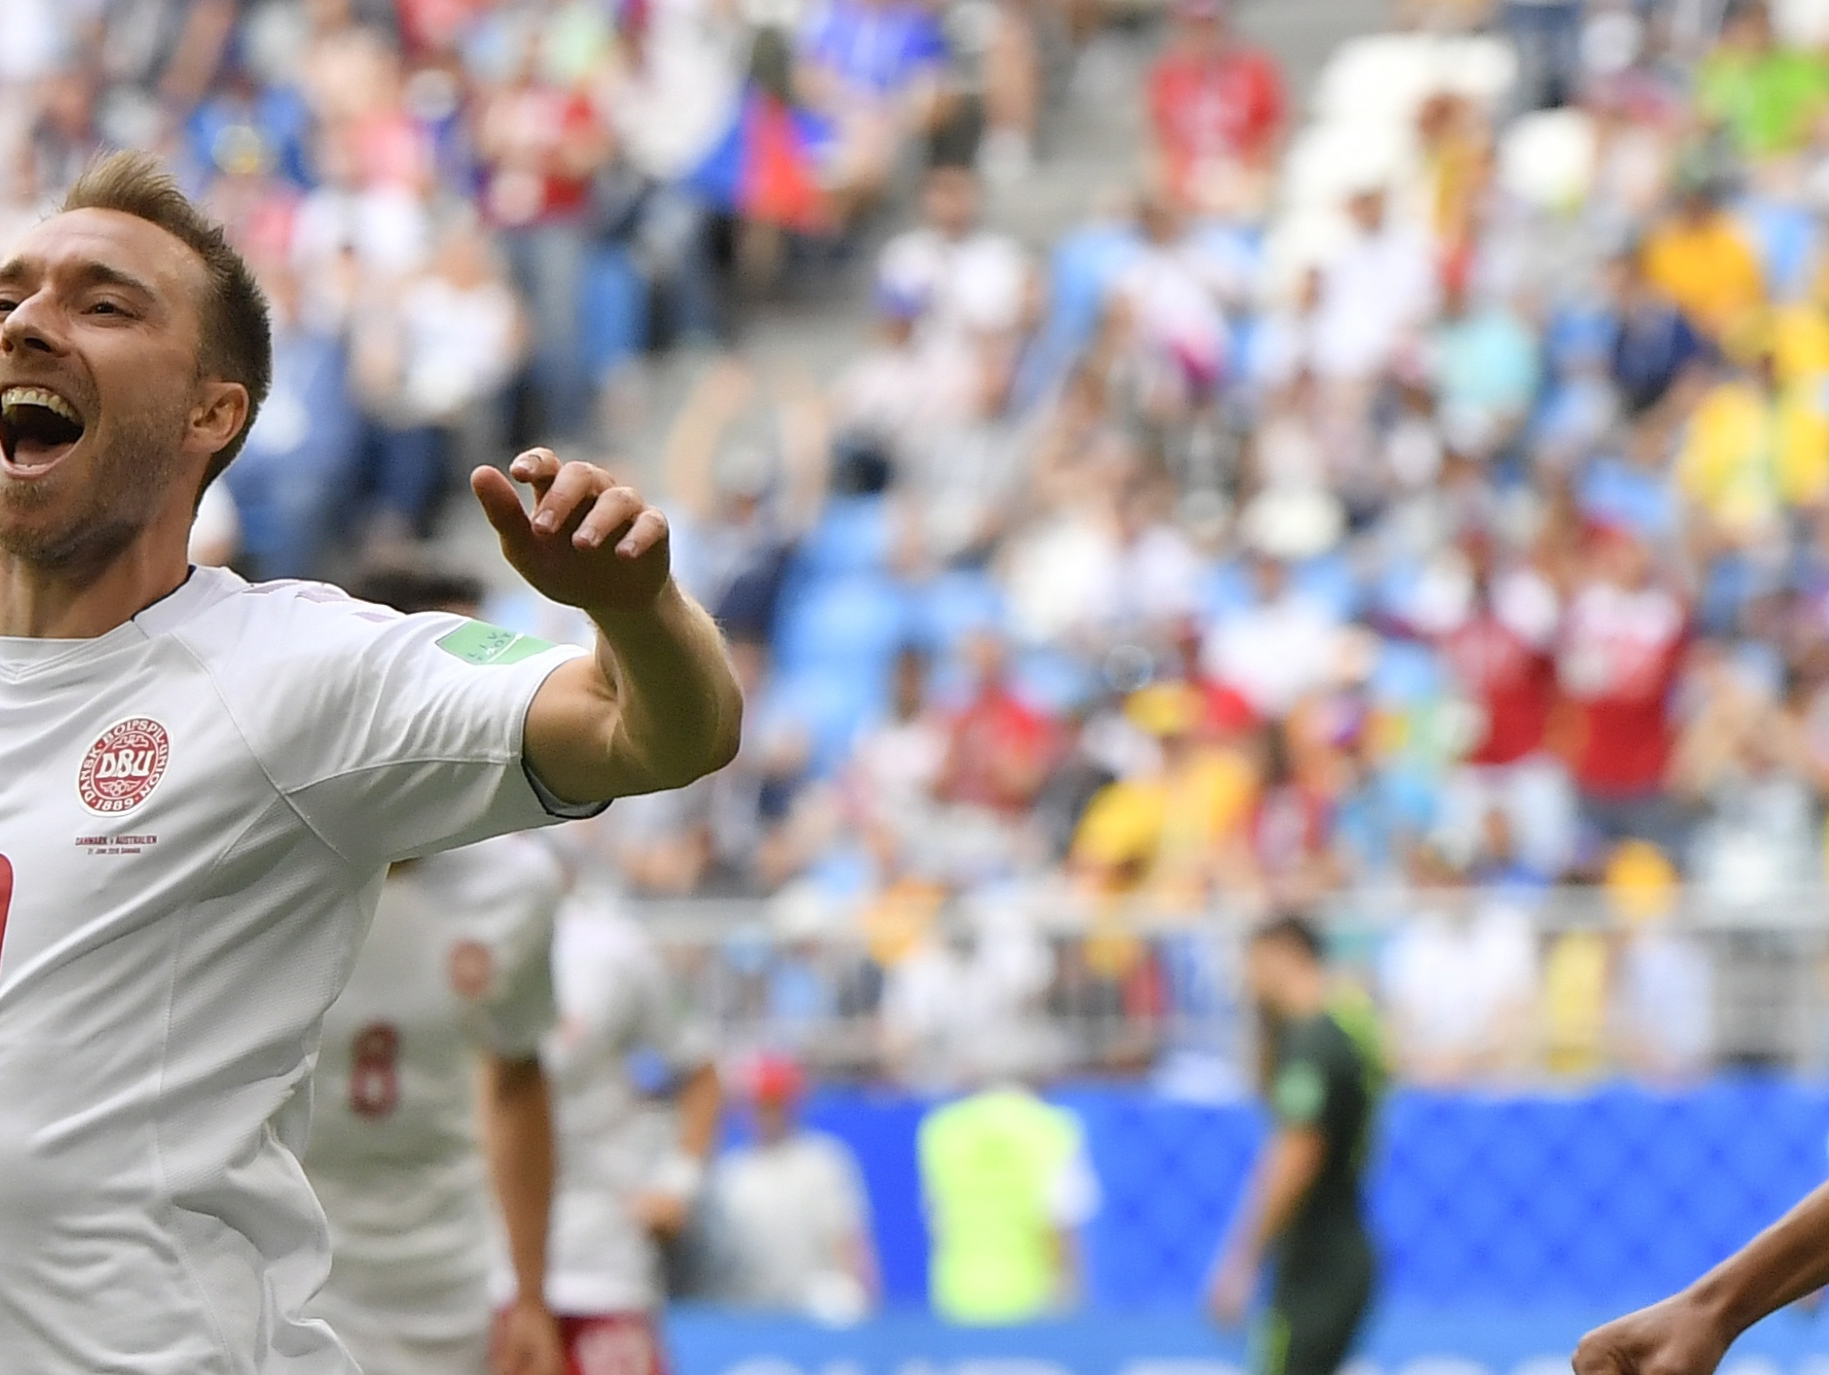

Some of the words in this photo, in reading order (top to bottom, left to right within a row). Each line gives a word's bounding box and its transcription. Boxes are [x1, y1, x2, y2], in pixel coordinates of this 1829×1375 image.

[80, 747, 102, 802] DANSK
[95, 749, 155, 778] DBU
[94, 798, 134, 811] 1889
[75, 836, 107, 846] DANMARK
[116, 835, 157, 845] AUSTRALIEN
[350, 1019, 400, 1119] 8
